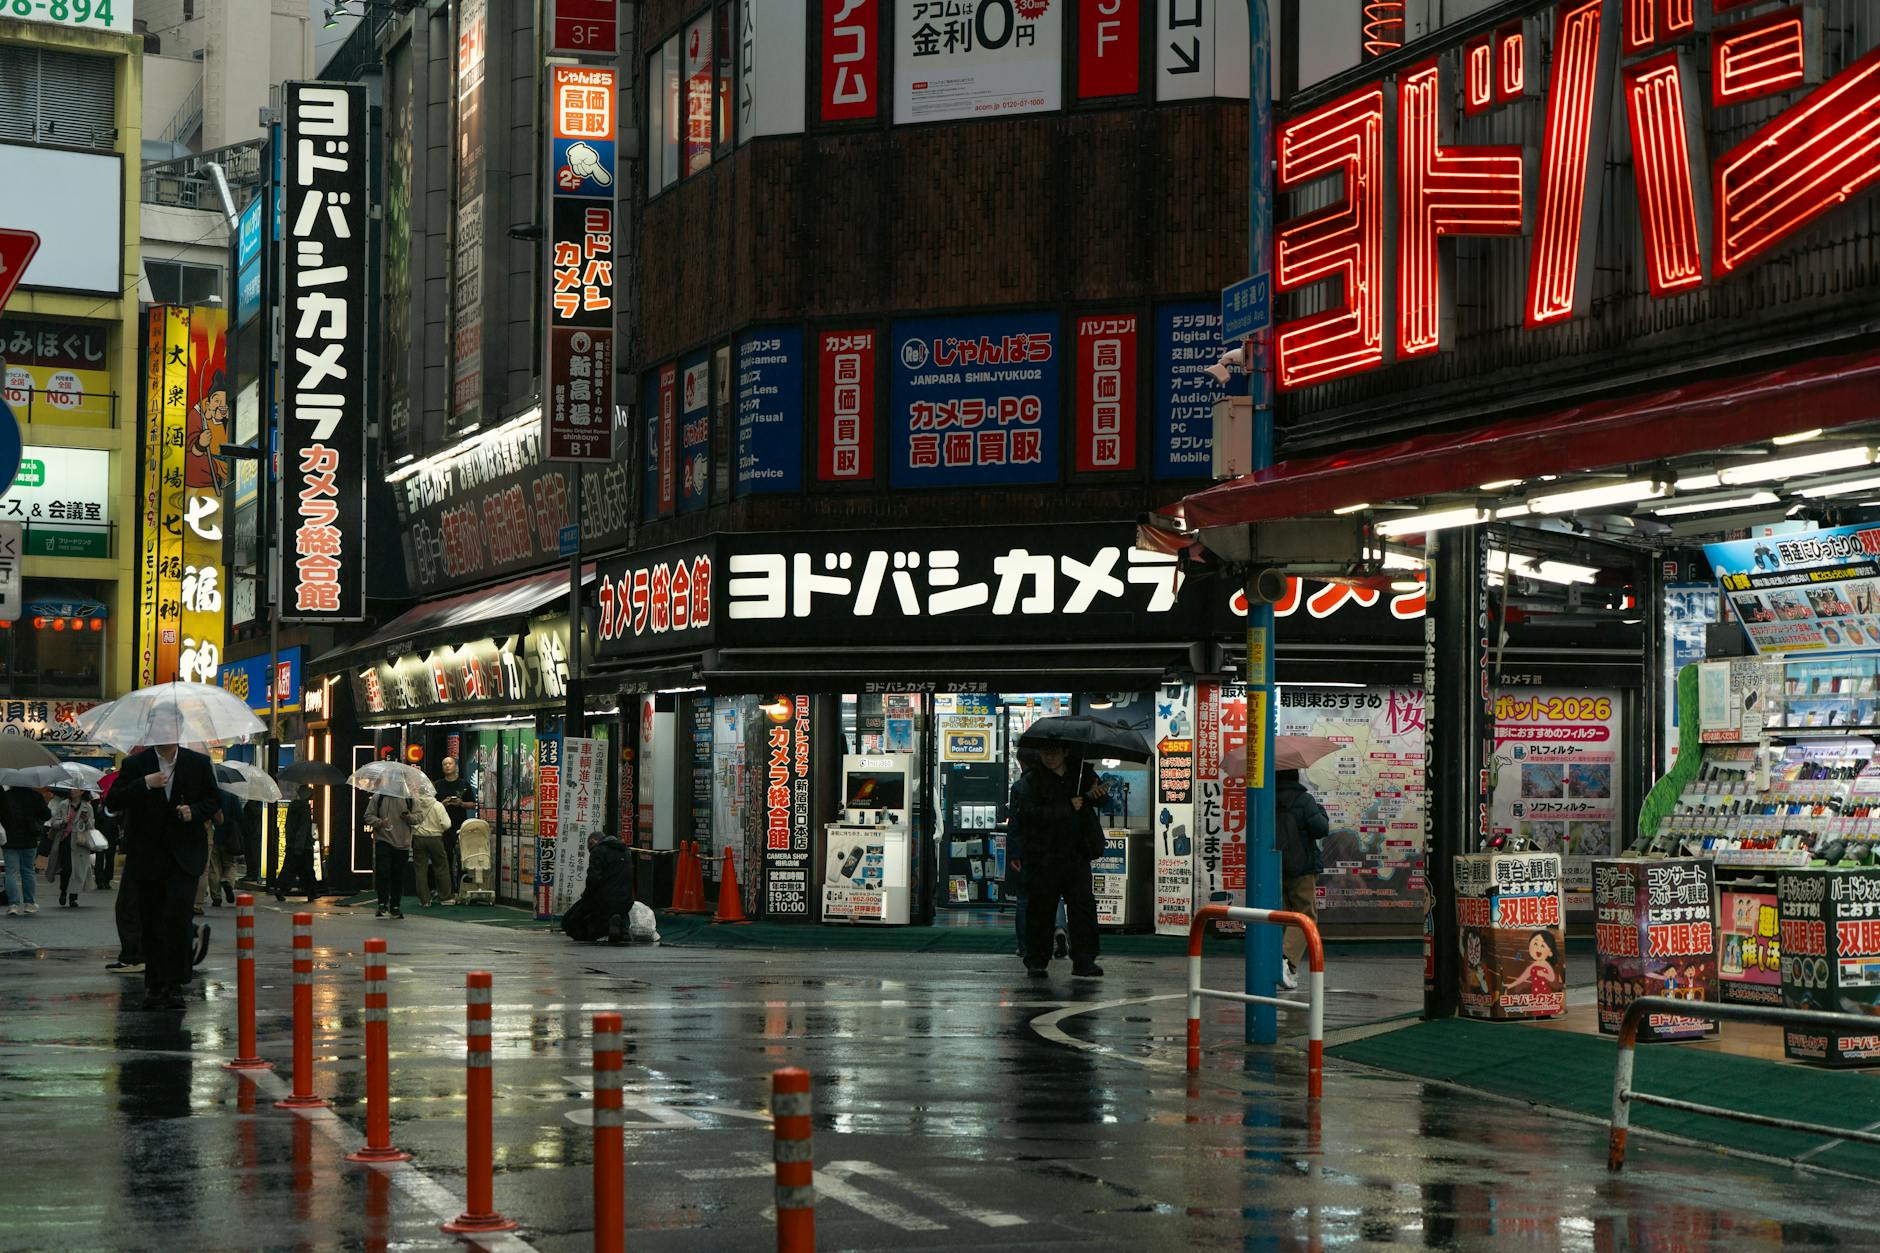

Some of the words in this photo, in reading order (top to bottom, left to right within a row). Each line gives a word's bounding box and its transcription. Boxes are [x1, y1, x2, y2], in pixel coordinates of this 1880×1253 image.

[912, 0, 974, 20] アコムは
[571, 25, 600, 45] 3F
[911, 0, 1036, 57] 金利0円
[564, 89, 605, 111] 高価
[564, 112, 605, 133] 買取
[559, 170, 581, 190] 2F
[292, 87, 351, 441] ヨドバシカメラ
[583, 207, 612, 311] ヨドバシ
[554, 241, 581, 319] カメラ
[1080, 318, 1136, 336] パソコン!
[1172, 331, 1210, 344] Digital
[825, 334, 872, 352] カメラ!
[753, 385, 778, 395] Lens
[910, 373, 961, 386] JANPARA
[1094, 340, 1118, 463] 高価買取
[836, 356, 858, 474] 高価買取
[1170, 422, 1187, 434] PC
[909, 429, 1043, 469] 高価買取
[1169, 452, 1210, 463] Mobile
[31, 502, 43, 517] &
[48, 500, 102, 521] 会議室
[296, 444, 342, 612] カメラ総合館
[729, 547, 1187, 620] ヨドバシカメラ
[599, 554, 711, 641] カメラ総合館
[503, 630, 567, 700] カメラ総合
[1488, 695, 1612, 721] ポット2026
[795, 695, 810, 778] ヨドバシカメラ
[1162, 741, 1190, 752] こちらです
[550, 739, 559, 765] カメラ
[1530, 746, 1583, 756] PLフィルター
[767, 726, 791, 851] カメラ総合館
[1530, 802, 1595, 812] ソフトフィルター
[1202, 782, 1221, 892] いたします!
[767, 852, 792, 861] CAMERA
[792, 852, 809, 861] SHOP
[770, 871, 805, 881] 営業時間
[1496, 858, 1558, 882] 舞台・観劇
[1648, 865, 1707, 886] コンサート
[1499, 881, 1558, 896] におすすめ!
[1649, 885, 1709, 905] スポーツ観戦
[1499, 896, 1560, 928] 双眼鏡
[1649, 908, 1711, 922] におすすめ!
[1648, 922, 1713, 957] 双眼鏡
[1781, 920, 1827, 957] 双眼鏡
[1500, 992, 1564, 1007] ヨドバシカメラ
